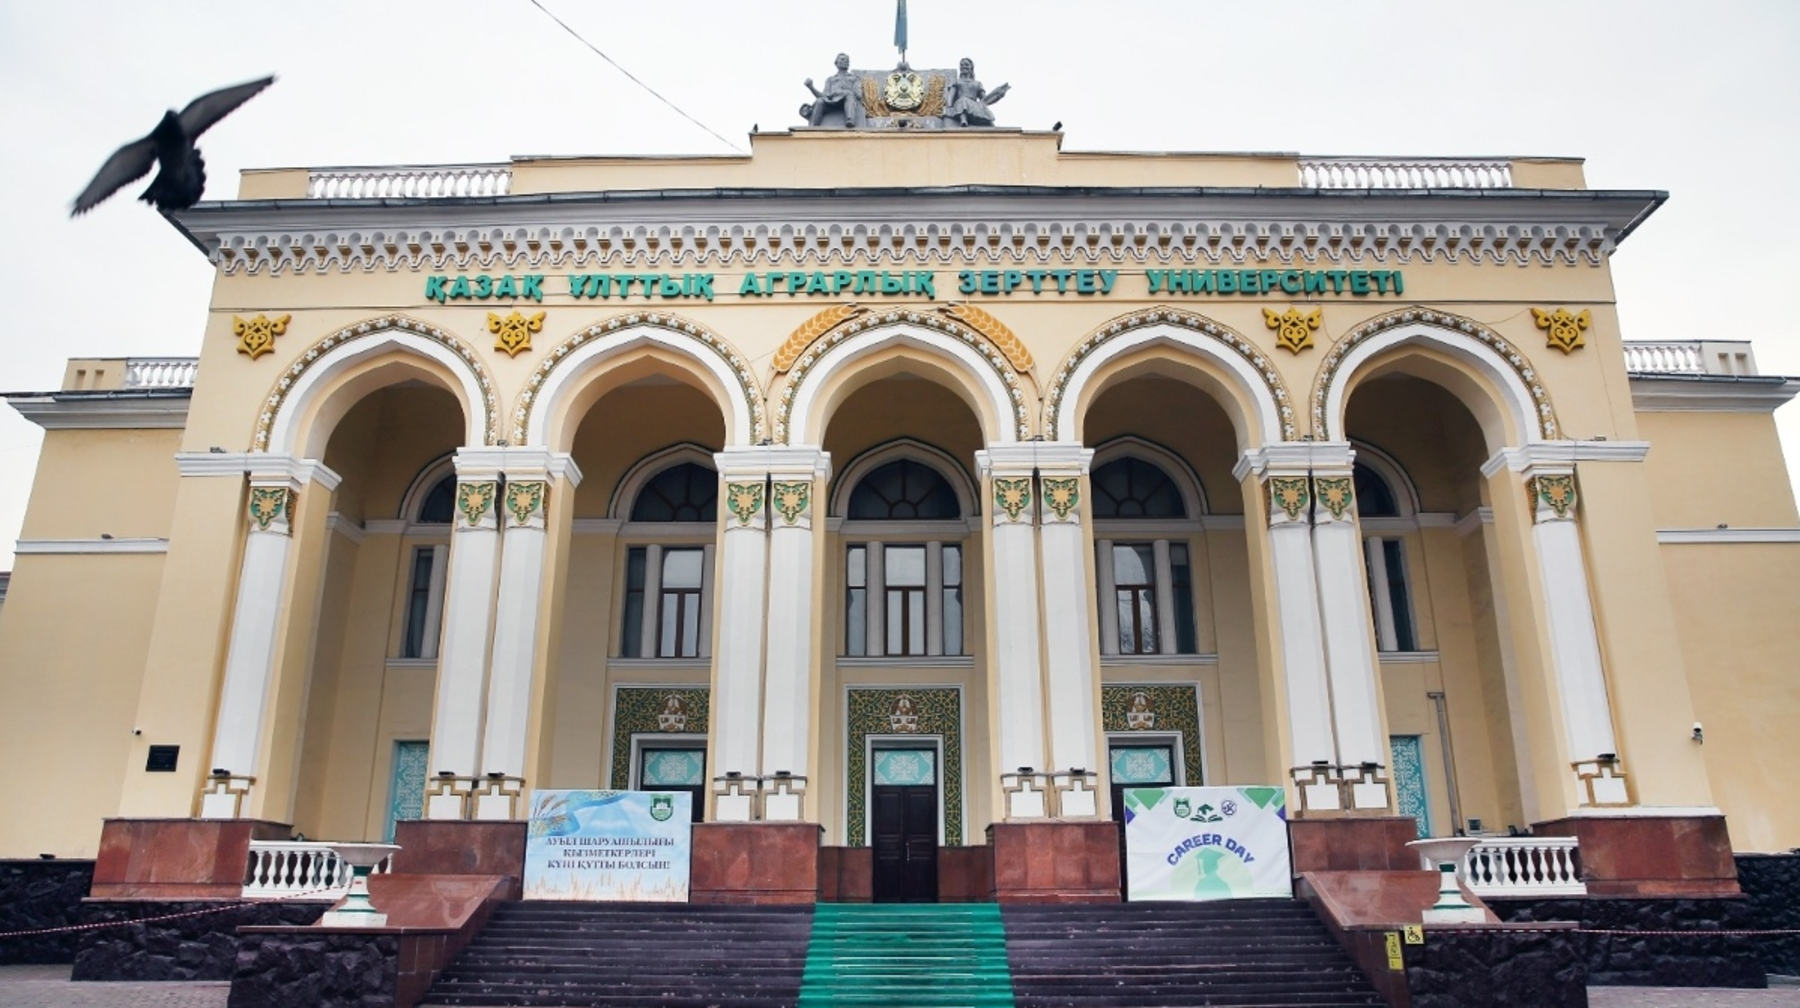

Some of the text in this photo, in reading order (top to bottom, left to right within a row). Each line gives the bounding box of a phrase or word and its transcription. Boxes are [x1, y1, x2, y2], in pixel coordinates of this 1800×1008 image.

[425, 269, 1405, 302] ҚАЗАҚ ҰЛТТЫҚ АГРАРЛЫҚ ЗЕРТТЕУ УНИВЕРСИТЕТІ
[1167, 833, 1255, 866] CAREER DAY
